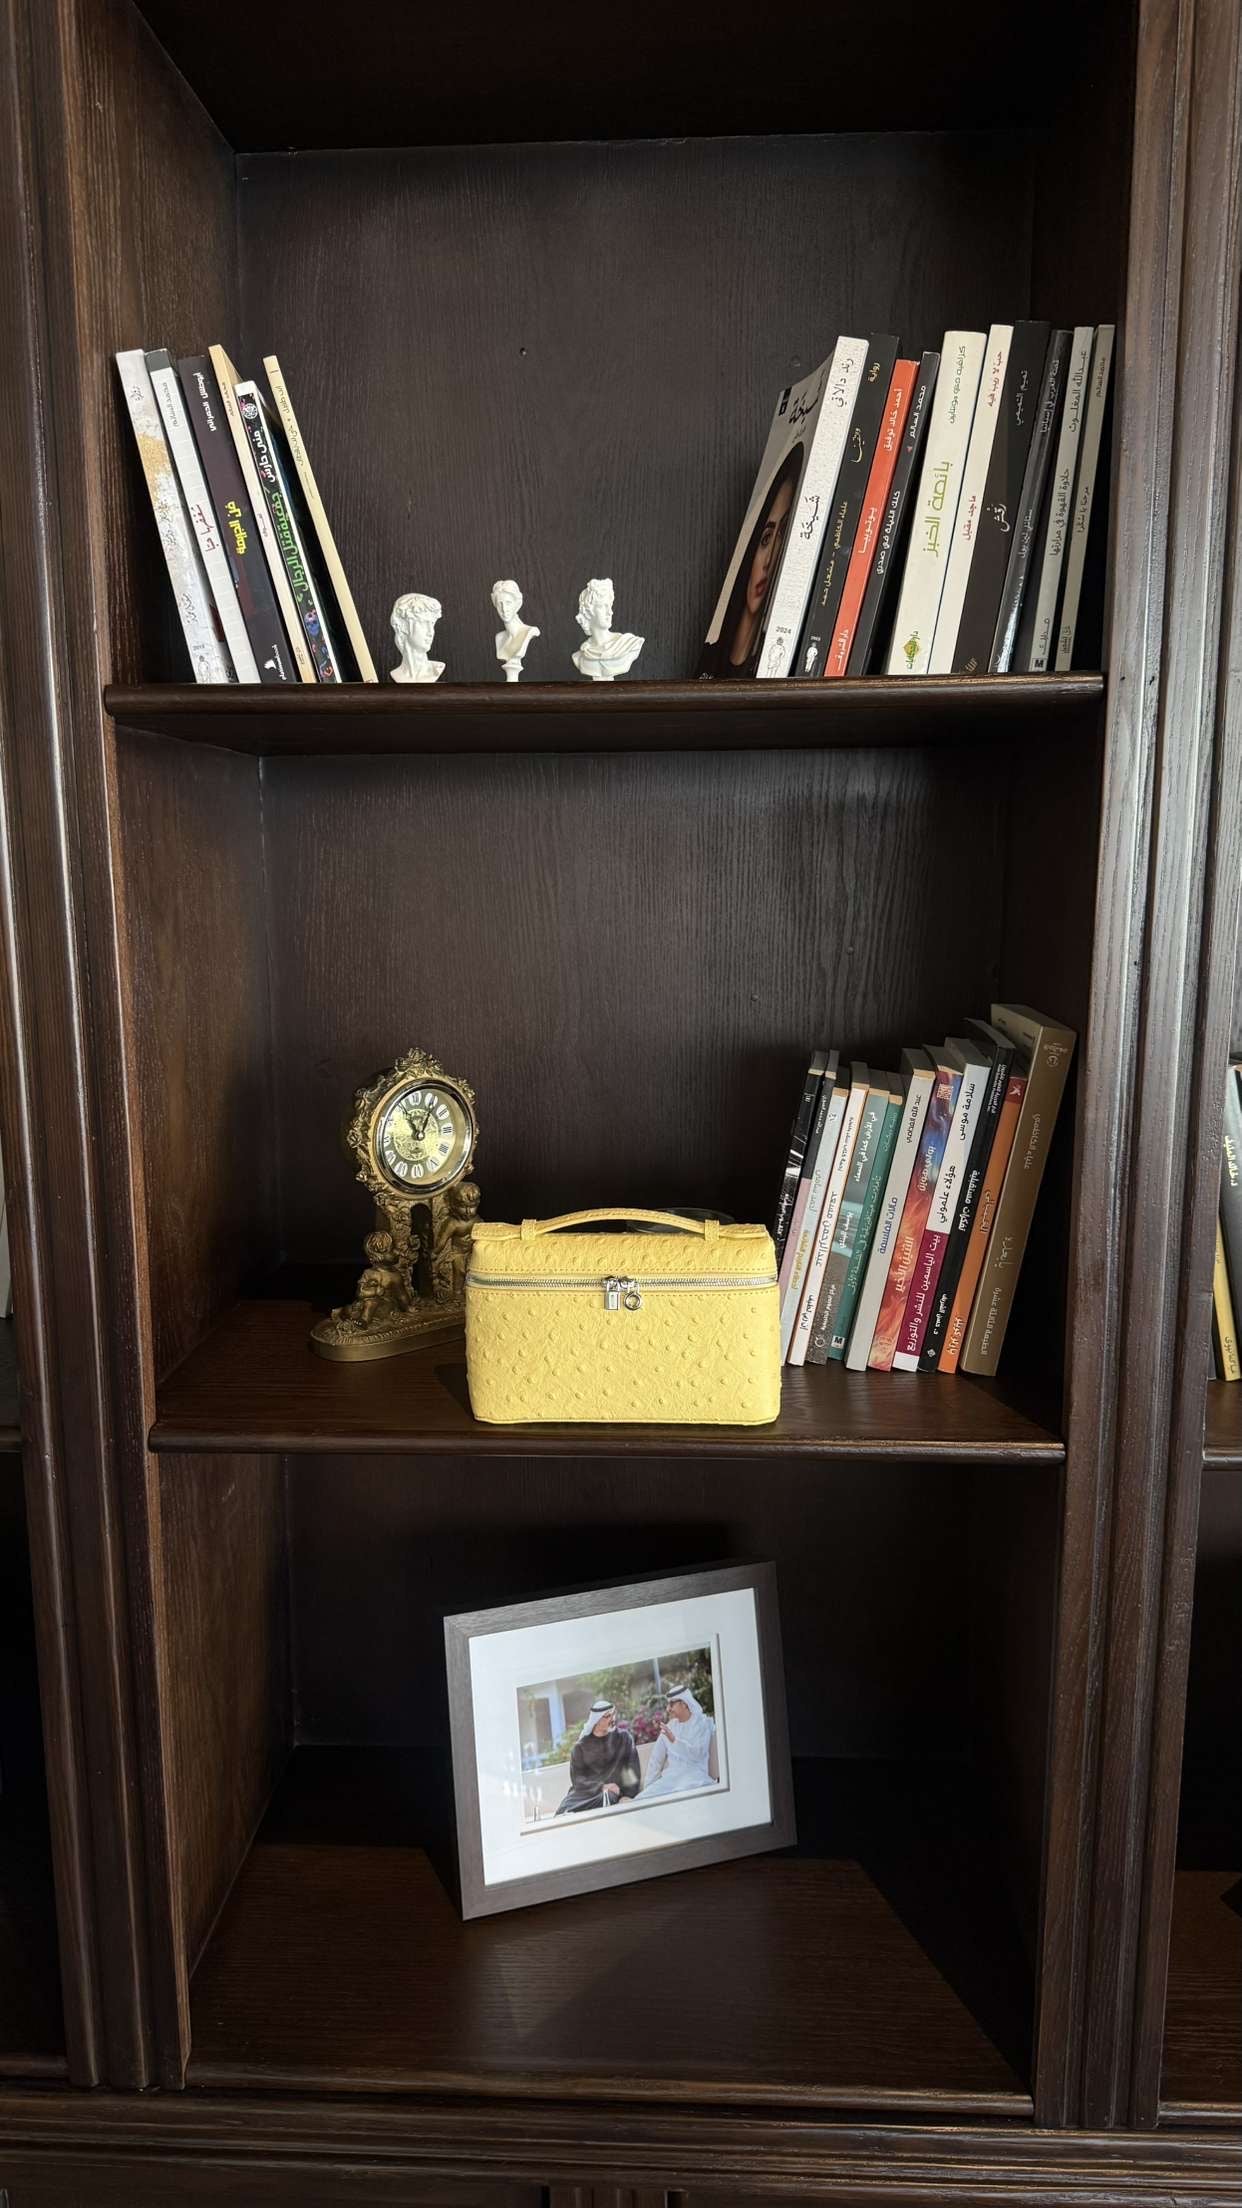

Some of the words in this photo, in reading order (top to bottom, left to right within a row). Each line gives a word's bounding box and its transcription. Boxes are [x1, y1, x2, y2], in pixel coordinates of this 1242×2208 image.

[838, 356, 854, 374] رند
[866, 360, 881, 382] رواية
[1048, 358, 1060, 377] قصة
[1072, 349, 1088, 387] عبدالله
[828, 375, 852, 408] دالاتي
[992, 377, 1000, 392] ريب
[1017, 369, 1030, 391] تميم
[1045, 376, 1058, 399] العرب
[889, 387, 903, 408] أحمد
[915, 384, 927, 410] محمد
[986, 393, 996, 407] فيه
[1011, 392, 1027, 426] التميمي
[886, 408, 898, 427] خالد
[1067, 388, 1083, 432] المغلوث
[908, 412, 921, 439] السالم
[250, 429, 267, 455] منى
[881, 427, 896, 452] توفيق
[257, 454, 276, 484] حارس
[1058, 467, 1072, 490] حلاوة
[223, 499, 242, 519] فن
[267, 490, 291, 532] جمعية
[889, 489, 900, 509] كلك
[965, 494, 977, 516] ماجد
[1055, 490, 1068, 516] القهوة
[190, 501, 214, 536] شغفها
[857, 506, 878, 554] يوتوبيا
[883, 508, 896, 534] الليلة
[961, 518, 974, 540] مقبل
[1053, 517, 1065, 527] في
[226, 517, 251, 555] الجريمة
[278, 528, 297, 556] قتل
[880, 534, 891, 550] في
[919, 514, 944, 557] الخبز
[1049, 528, 1063, 556] مرارتها
[286, 553, 309, 593] الرجال
[822, 558, 836, 586] مشعل
[874, 549, 888, 575] صدري
[913, 1093, 922, 1105] عبد
[961, 1081, 976, 1109] سلامة
[866, 1110, 878, 1122] في
[910, 1104, 919, 1117] الله
[861, 1121, 874, 1139] الأرض
[957, 1111, 971, 1140] موسى
[1024, 1112, 1044, 1151] الكاظمي
[856, 1151, 869, 1163] في
[859, 1139, 868, 1150] كما
[852, 1161, 864, 1182] السماء
[1020, 1150, 1035, 1170] علياء
[1228, 1161, 1239, 1179] خالد
[867, 1174, 882, 1201] تأملات
[942, 1163, 958, 1189] هؤلاء
[963, 1168, 980, 1205] مستقبلية
[933, 1189, 953, 1223] علموني
[956, 1205, 971, 1232] تفكرات
[842, 1210, 854, 1229] يوسف
[813, 1218, 834, 1268] عبدالرحمن
[878, 1219, 893, 1254] الفلسفة
[928, 1233, 940, 1251] بيت
[850, 1249, 864, 1274] الفلسفة
[899, 1235, 916, 1265] التنين
[891, 1263, 909, 1292] الأخير
[917, 1252, 937, 1291] الياسمين
[911, 1291, 928, 1316] للنشر
[936, 1292, 949, 1313] الشريف
[989, 1286, 1003, 1307] عشرة
[933, 1313, 943, 1327] حسن
[950, 1316, 967, 1337] كويلو
[985, 1306, 998, 1329] الثالثة
[903, 1315, 923, 1352] والتوزيع
[946, 1335, 962, 1355] باولو
[978, 1328, 993, 1355] الطبعة
